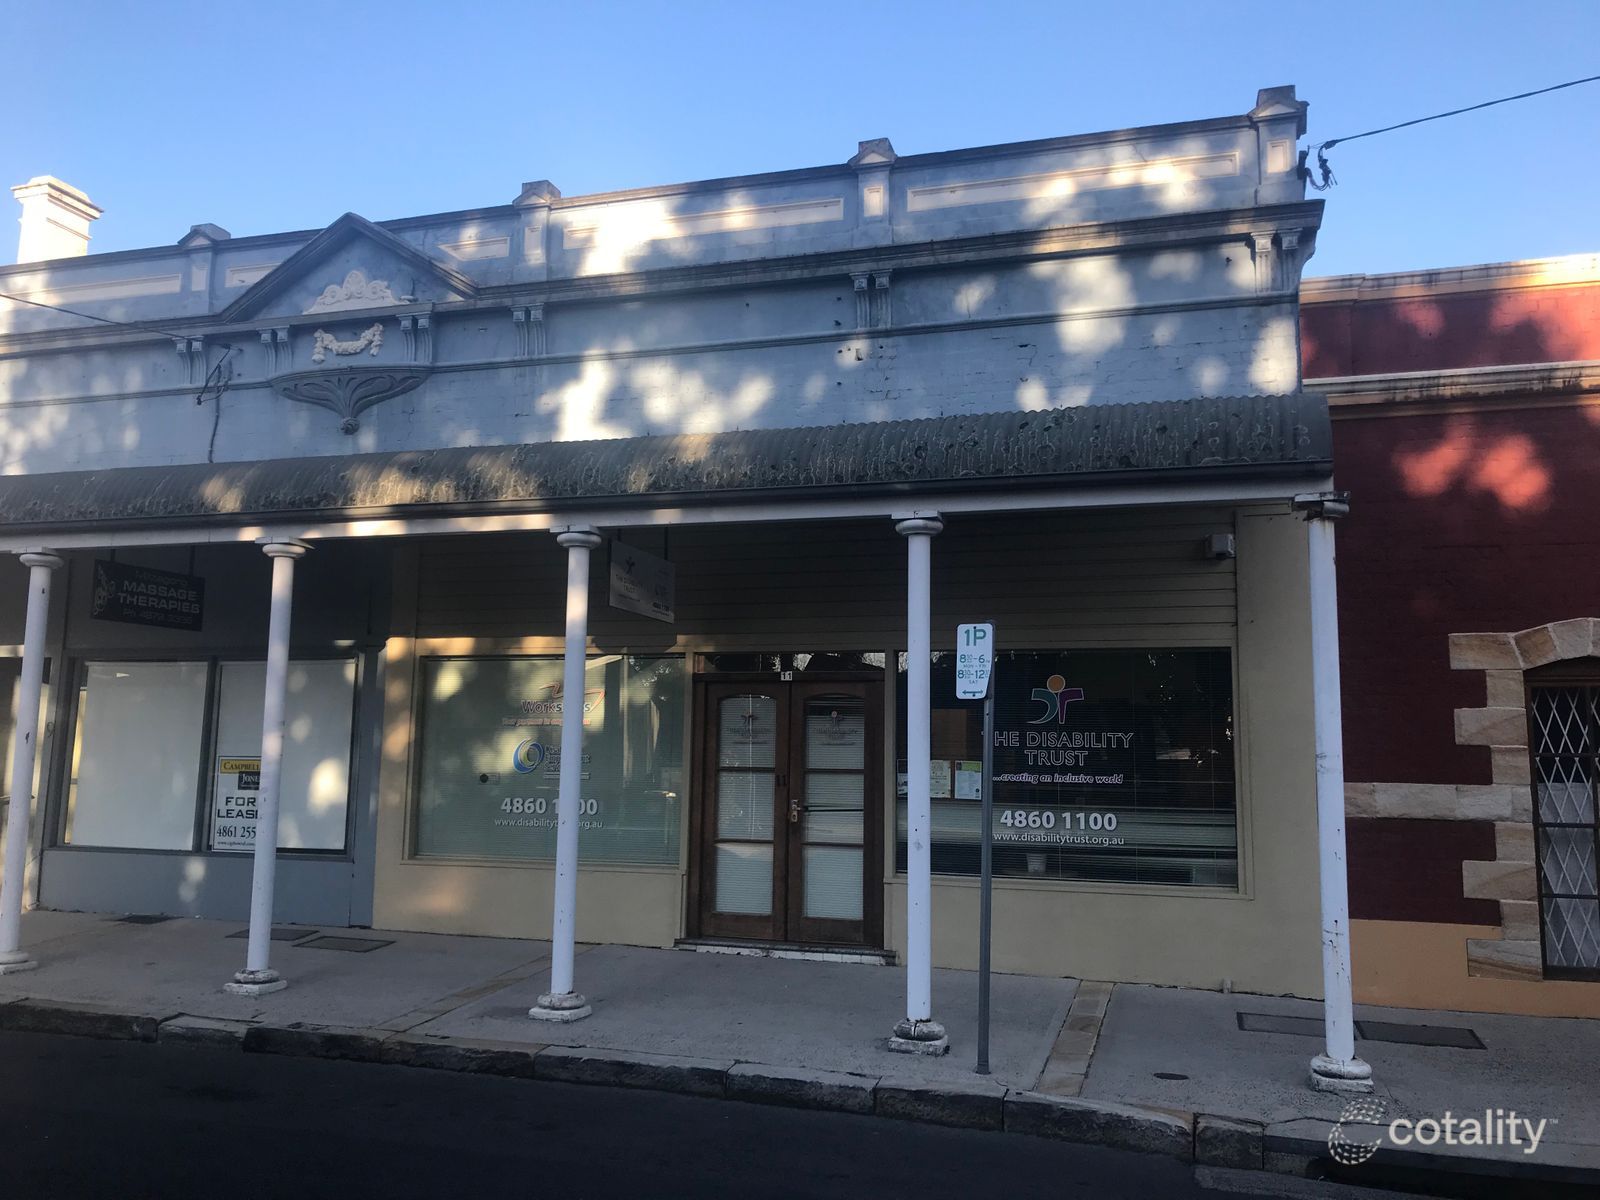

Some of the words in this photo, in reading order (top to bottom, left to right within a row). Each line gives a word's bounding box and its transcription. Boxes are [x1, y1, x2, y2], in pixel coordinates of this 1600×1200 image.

[123, 580, 198, 601] MASSAGE
[117, 593, 201, 614] THERAPIES
[964, 629, 987, 646] 1P
[782, 672, 792, 680] 11
[993, 731, 1020, 747] HE
[1027, 731, 1135, 749] DISABILITY
[1025, 750, 1089, 767] TRUST
[1040, 774, 1052, 782] an
[1053, 772, 1094, 784] inclusive
[1095, 774, 1124, 785] world
[225, 796, 257, 807] FOR
[500, 797, 547, 815] 4860
[999, 811, 1056, 829] 4860
[1061, 812, 1117, 831] 1100
[216, 824, 238, 838] 4861
[239, 825, 257, 840] 255
[993, 831, 1125, 847] www.disabilitytrust.org.au
